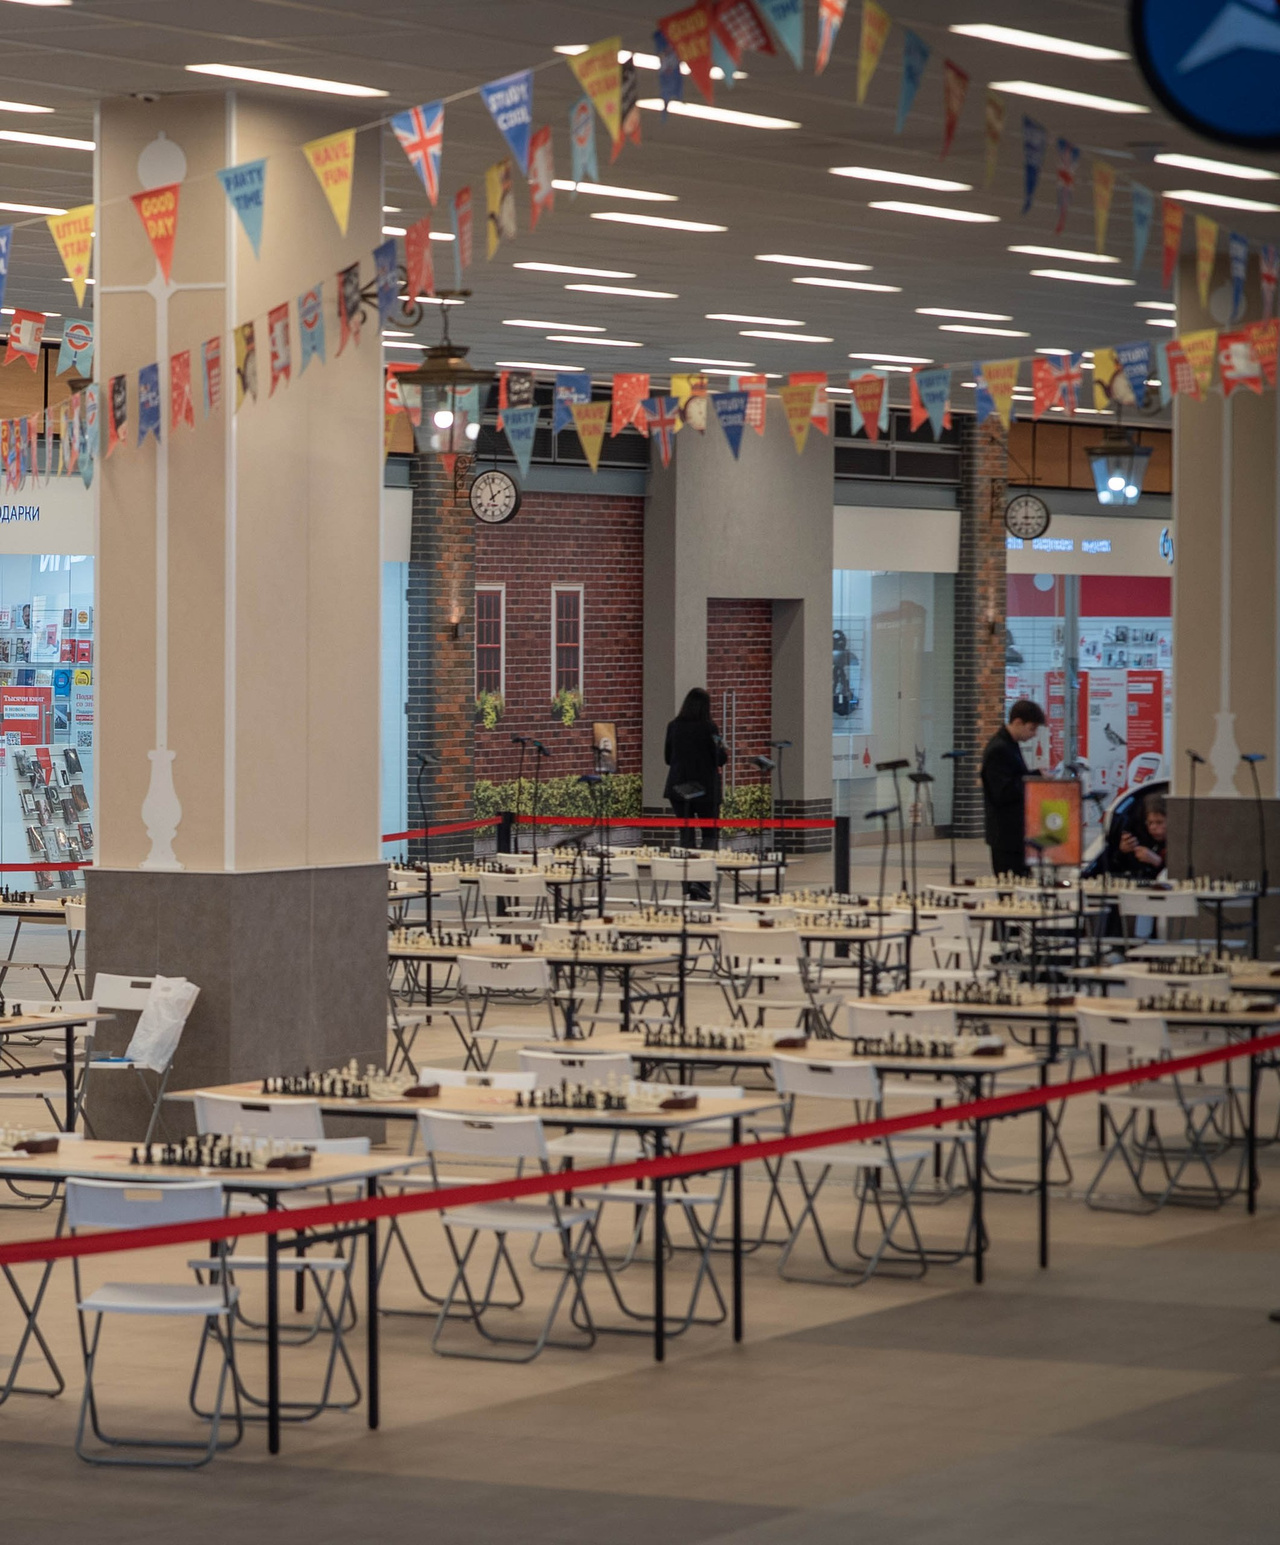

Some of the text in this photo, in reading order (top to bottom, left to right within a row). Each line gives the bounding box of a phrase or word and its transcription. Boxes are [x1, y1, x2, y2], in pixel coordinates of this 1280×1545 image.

[140, 192, 175, 218] GOOD
[55, 216, 91, 239] LITTLE
[147, 216, 175, 239] DAY
